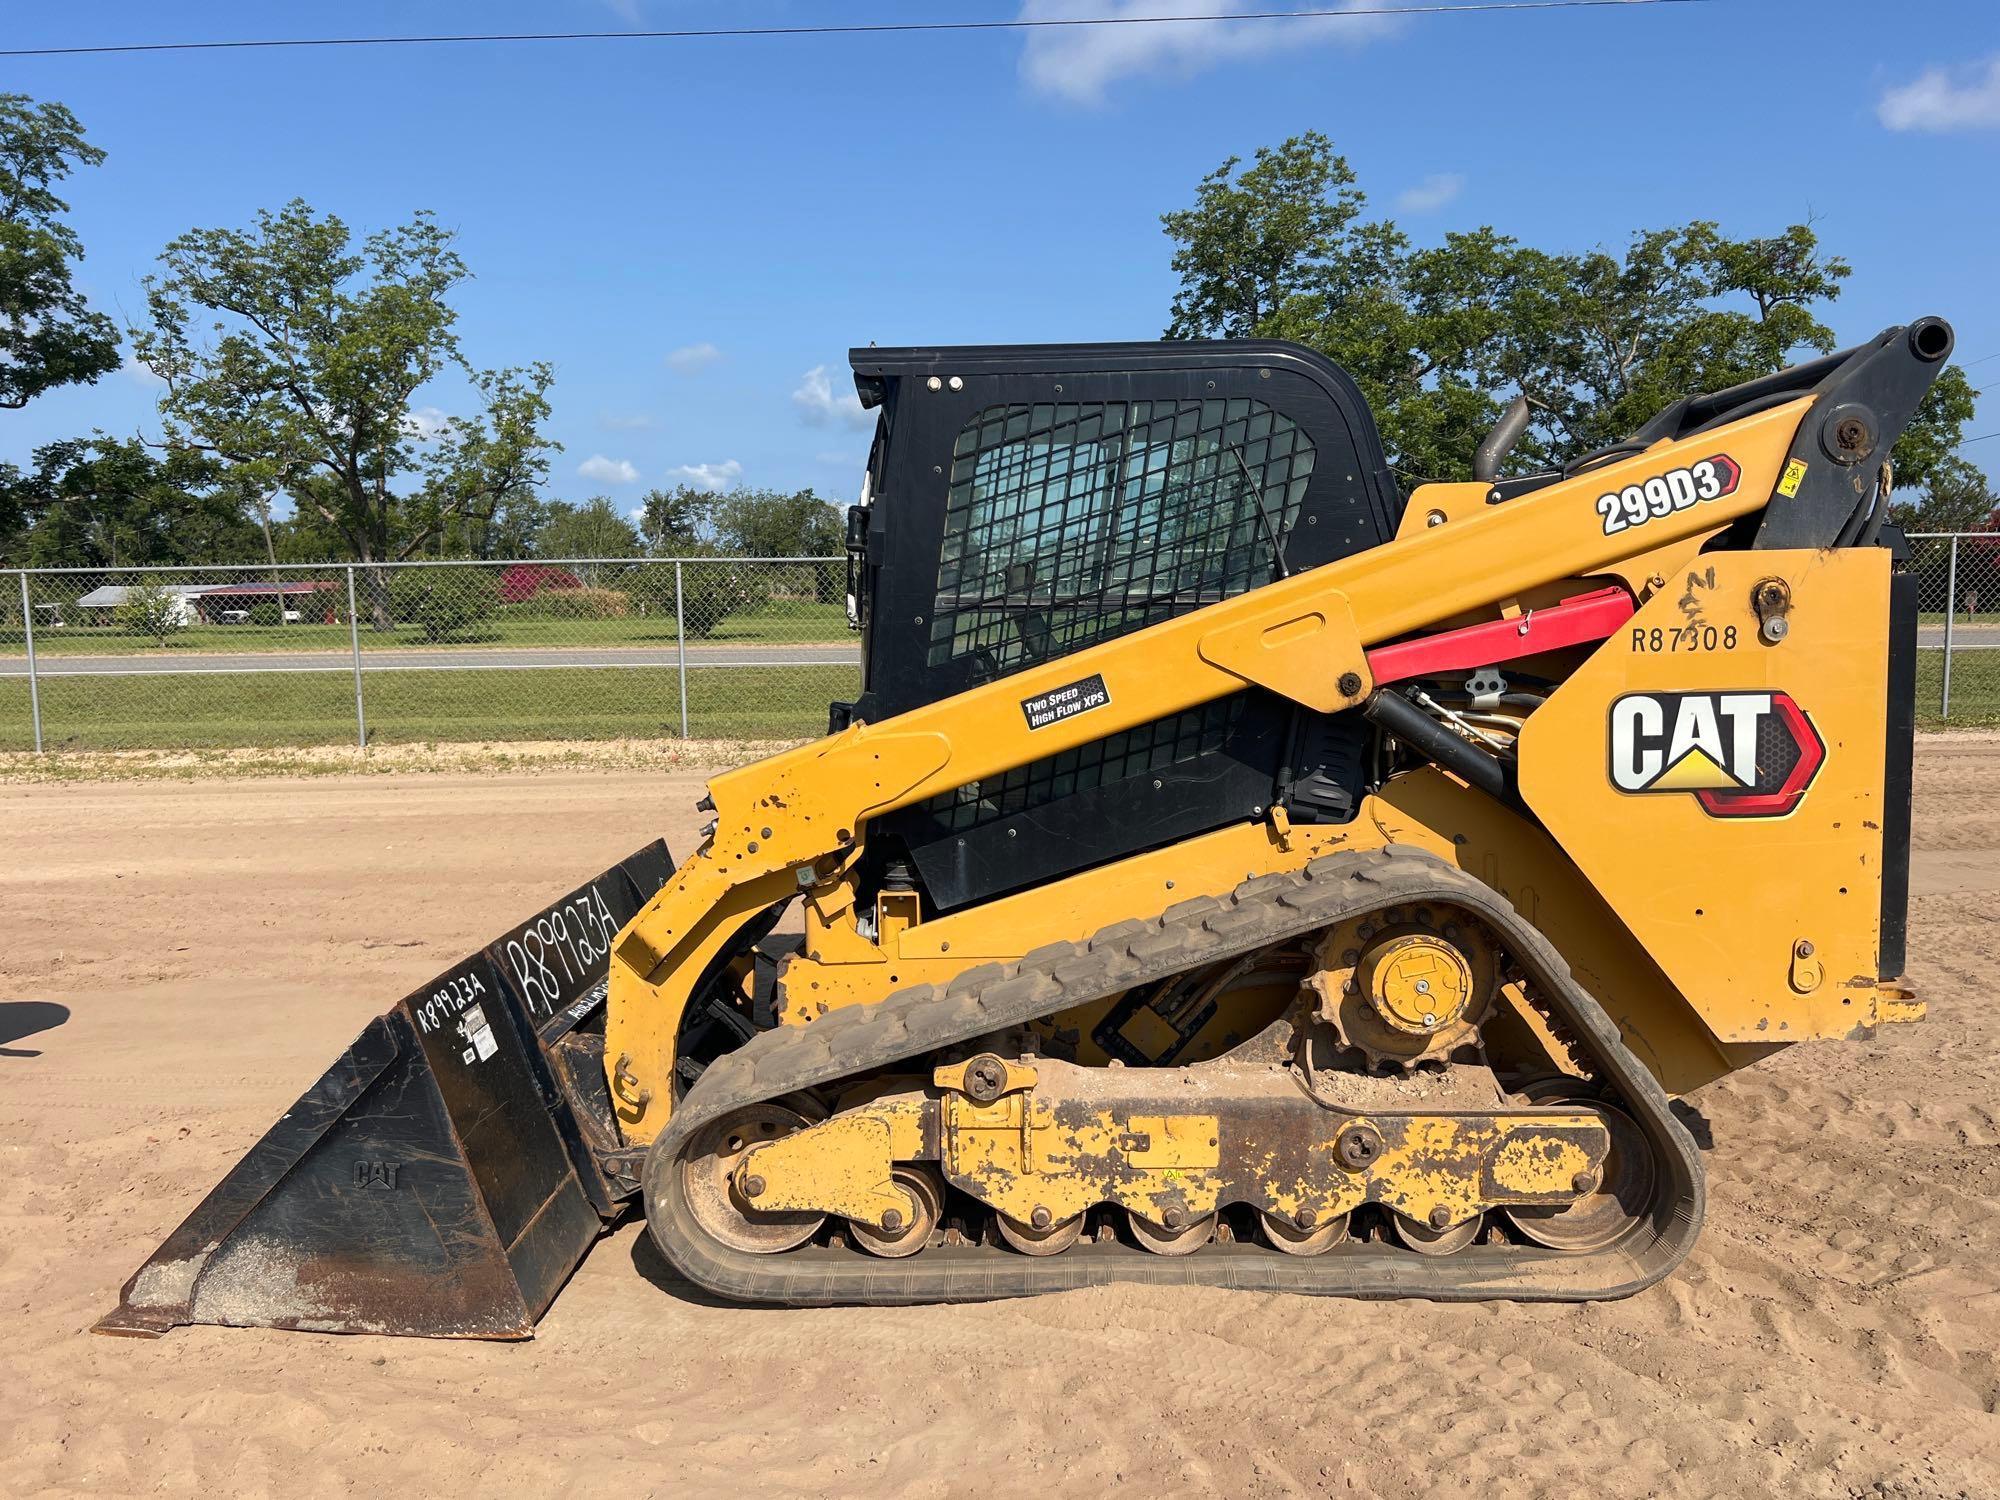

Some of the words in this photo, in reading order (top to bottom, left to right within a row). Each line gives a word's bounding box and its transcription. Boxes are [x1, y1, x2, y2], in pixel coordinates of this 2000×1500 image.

[1598, 460, 1721, 534] 299D3
[1632, 625, 1737, 652] R87308
[1083, 691, 1105, 708] XPS
[1612, 694, 1771, 790] CAT
[507, 885, 620, 1015] R89923A
[416, 972, 487, 1034] R89923A
[353, 1160, 401, 1190] CAT
